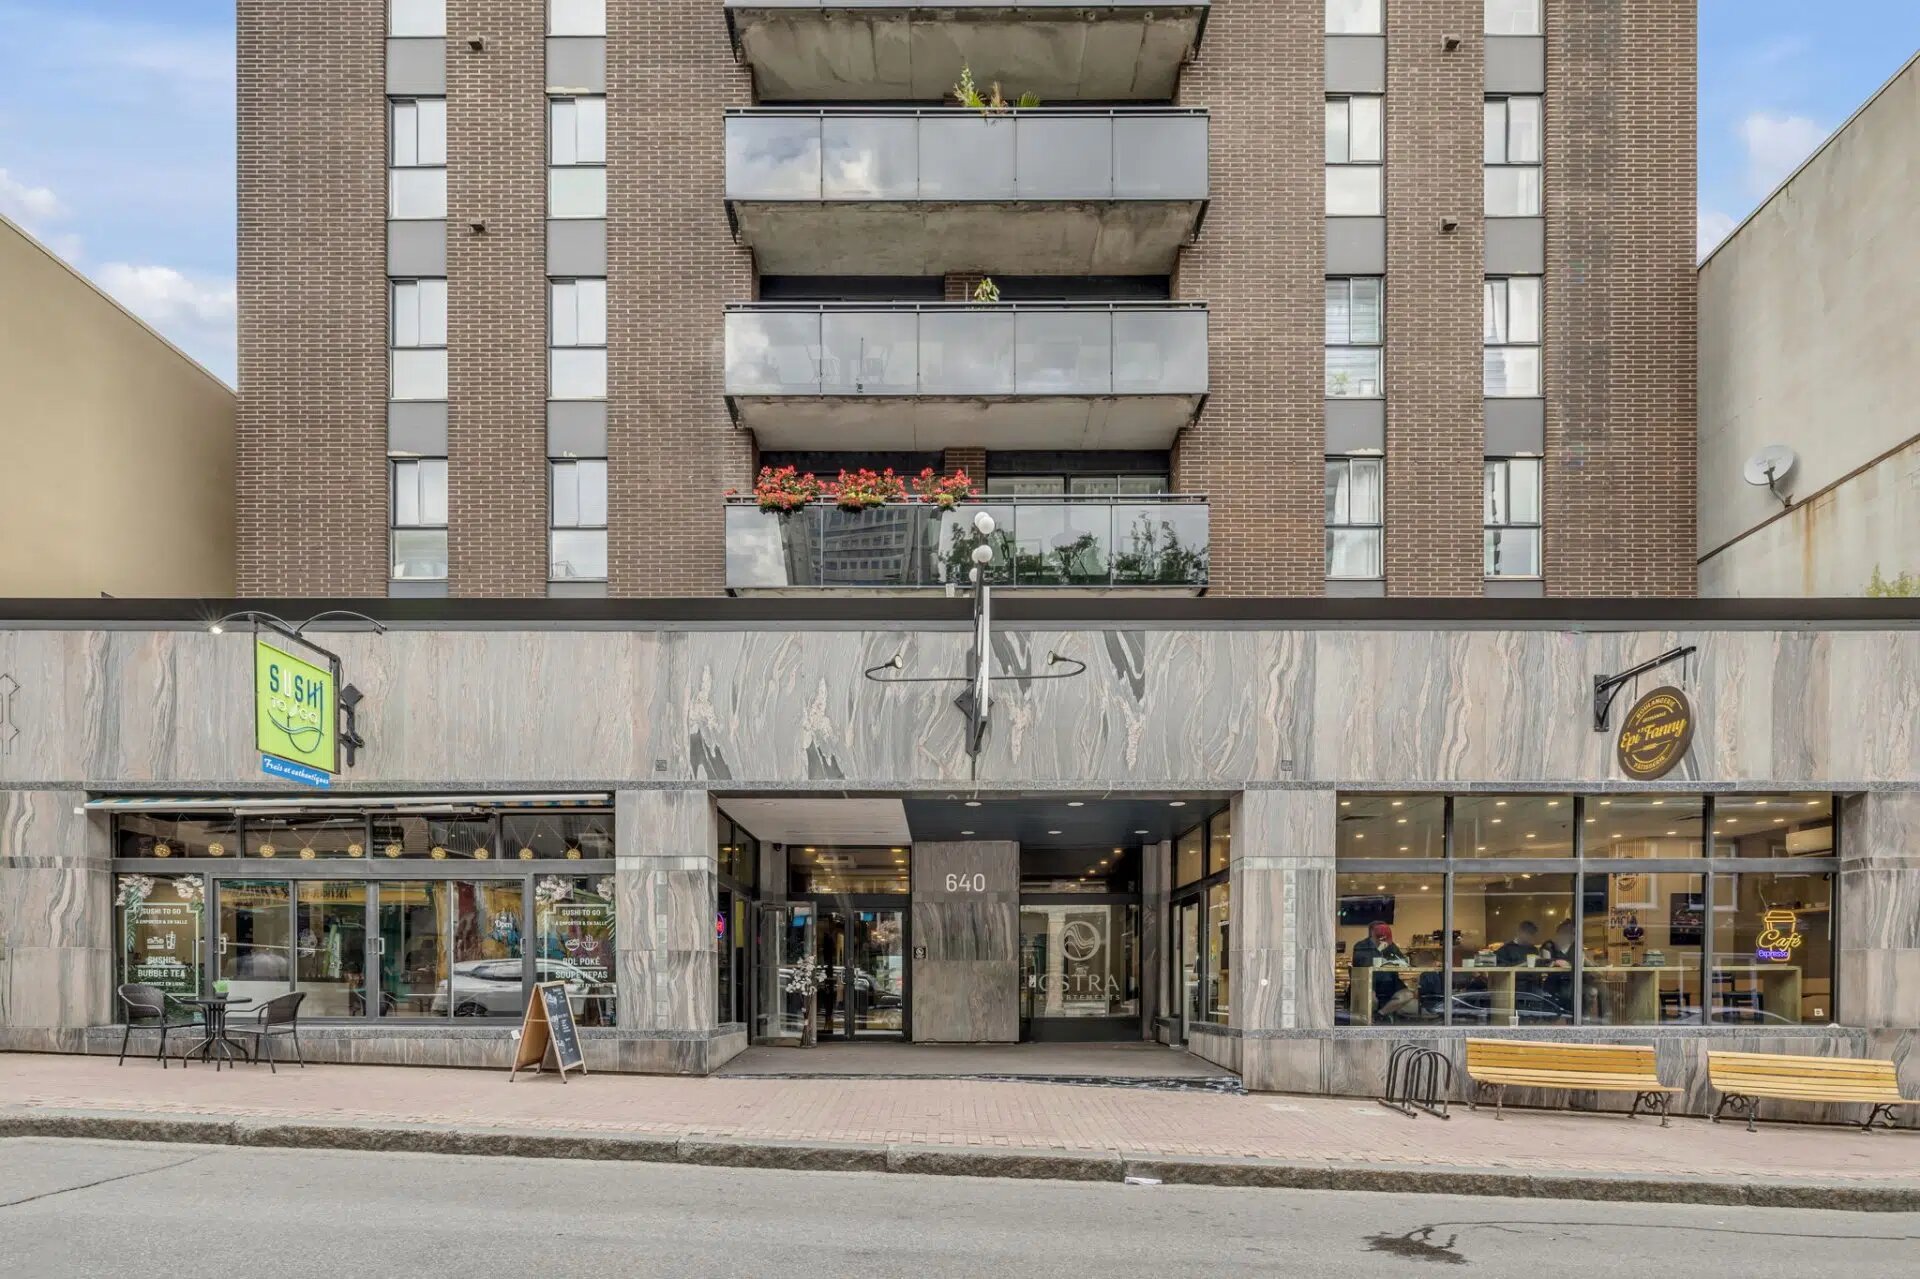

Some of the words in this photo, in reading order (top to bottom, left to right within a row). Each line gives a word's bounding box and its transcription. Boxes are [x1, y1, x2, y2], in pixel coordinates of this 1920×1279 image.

[269, 664, 323, 708] SUSHI
[1642, 718, 1687, 740] Fanny
[263, 757, 283, 772] Frais
[945, 872, 986, 892] 640
[1758, 928, 1802, 952] Café
[147, 956, 176, 965] SUSHIS
[580, 956, 600, 965] POKÉ
[137, 969, 168, 977] BUBBLE
[170, 969, 185, 977] TEA
[555, 970, 581, 979] SOUPE
